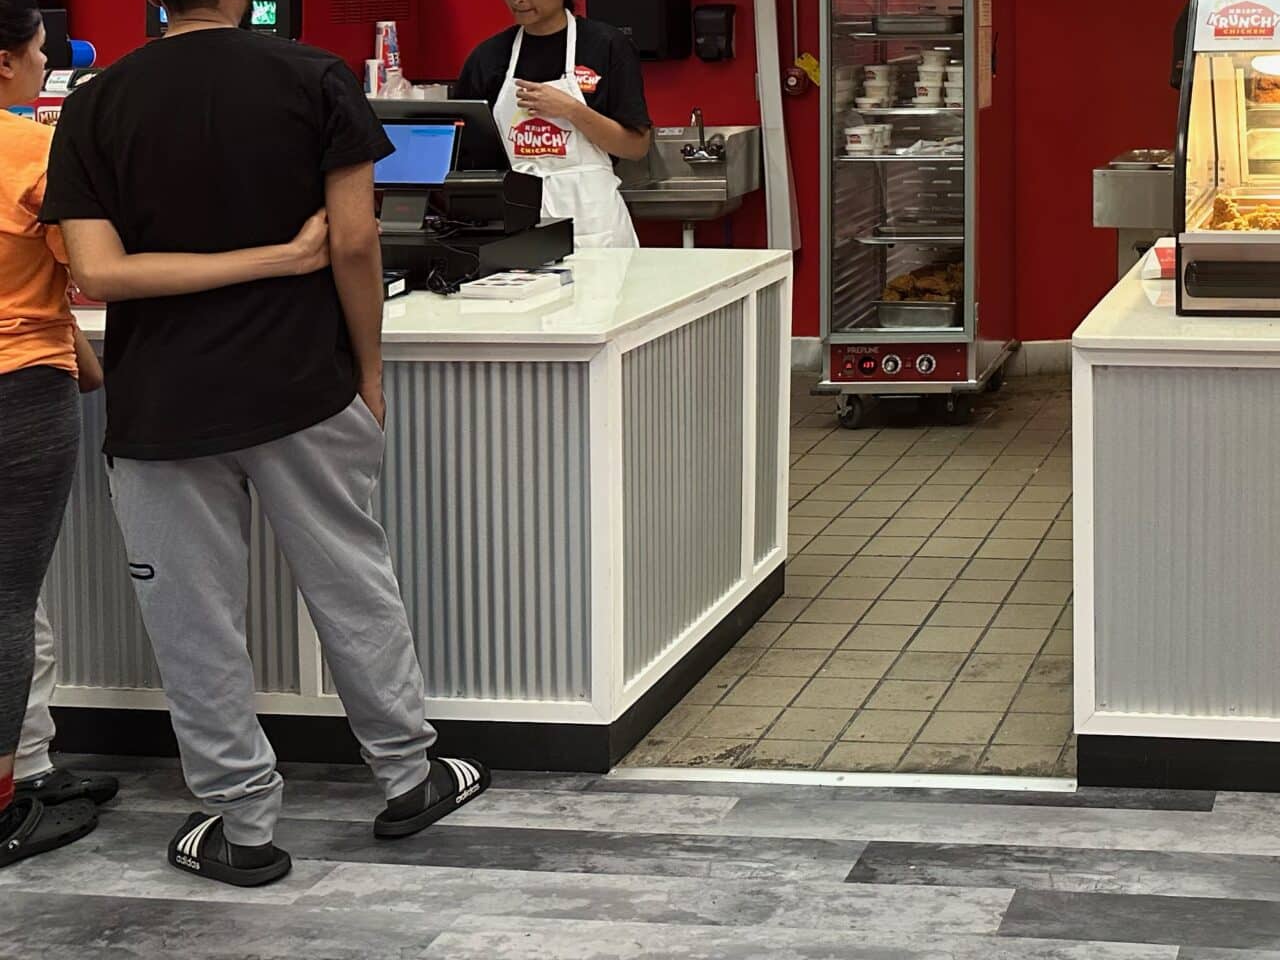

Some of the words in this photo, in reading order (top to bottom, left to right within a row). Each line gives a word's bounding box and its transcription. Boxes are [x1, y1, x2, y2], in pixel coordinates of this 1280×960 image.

[508, 127, 572, 148] KRUNCHY
[455, 783, 481, 804] adidas
[175, 855, 201, 870] adidas
